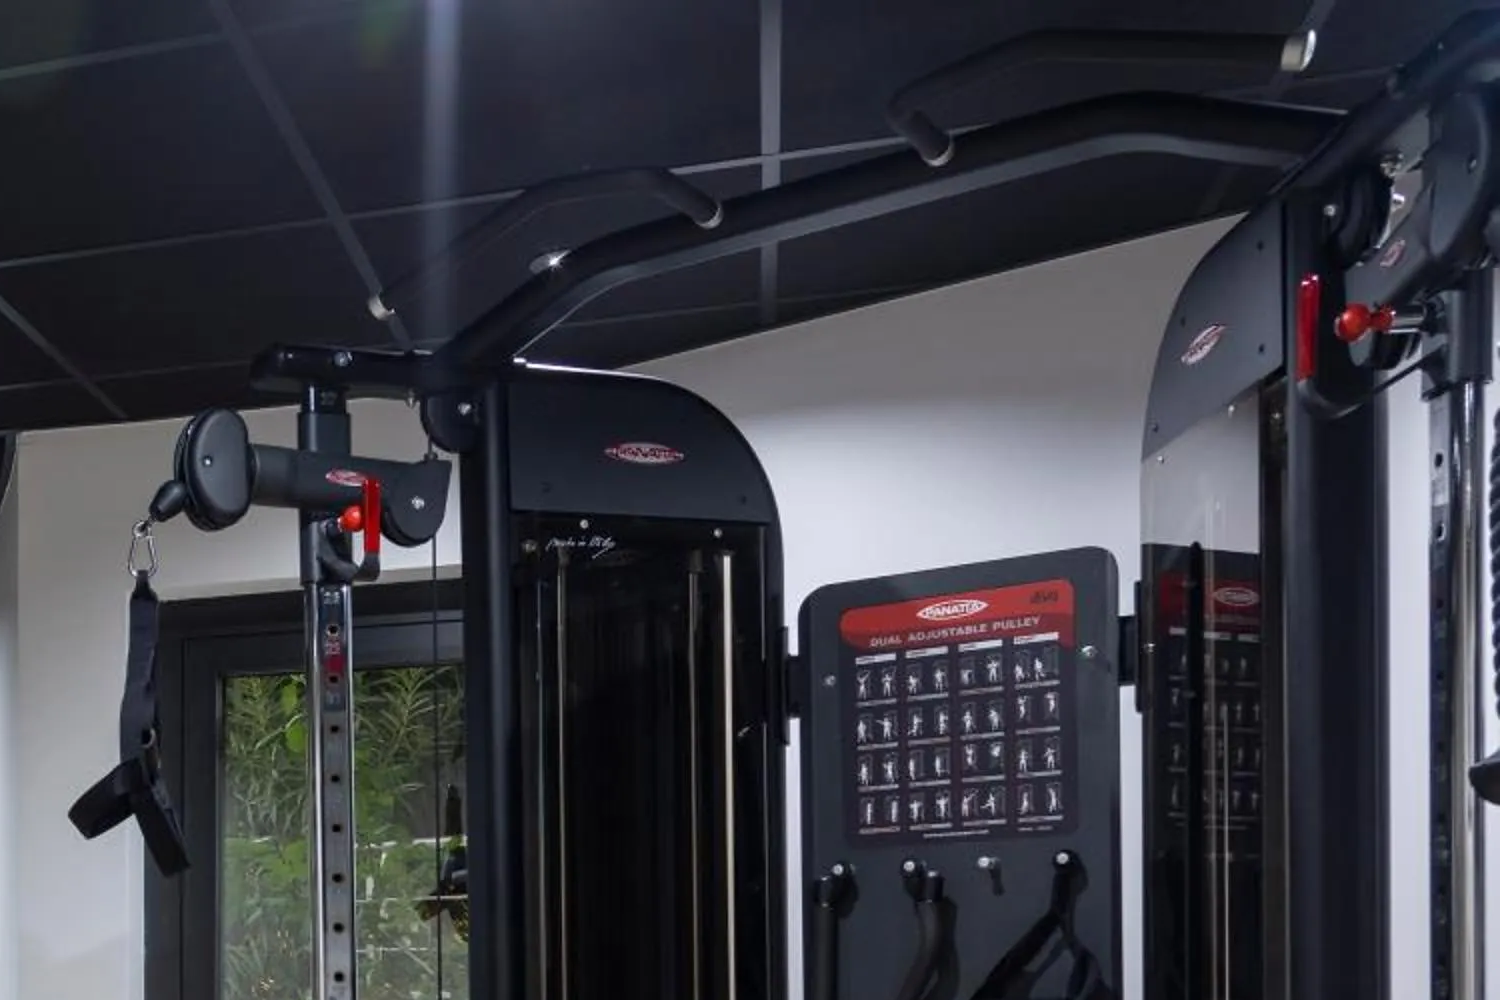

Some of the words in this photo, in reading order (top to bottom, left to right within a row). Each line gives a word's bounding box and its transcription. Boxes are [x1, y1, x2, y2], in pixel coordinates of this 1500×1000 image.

[869, 636, 903, 648] DUAL
[908, 623, 988, 642] ADJUSTABLE
[993, 615, 1041, 632] PULLEY
